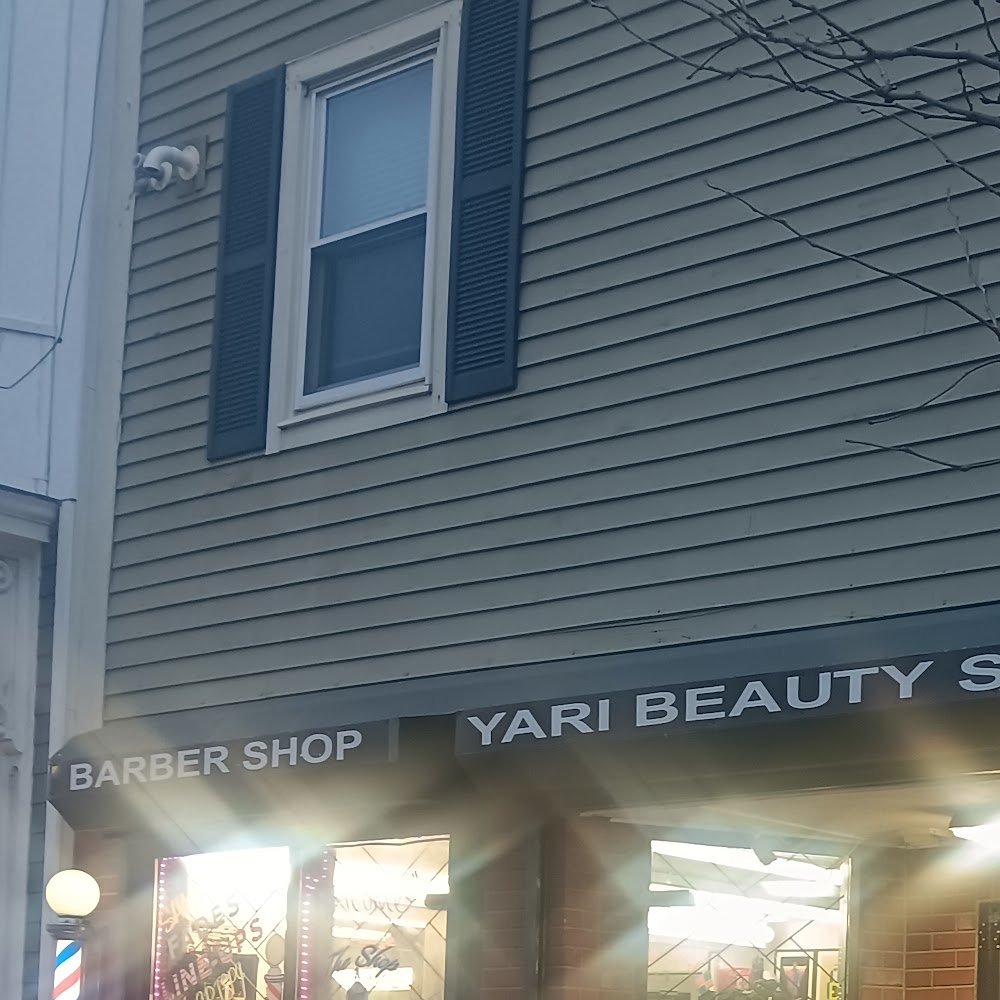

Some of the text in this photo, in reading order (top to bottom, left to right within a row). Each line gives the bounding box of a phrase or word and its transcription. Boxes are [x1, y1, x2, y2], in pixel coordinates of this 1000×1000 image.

[466, 699, 610, 747] YARI
[634, 661, 935, 729] BEAUTY
[69, 729, 364, 791] BARBER SHOP
